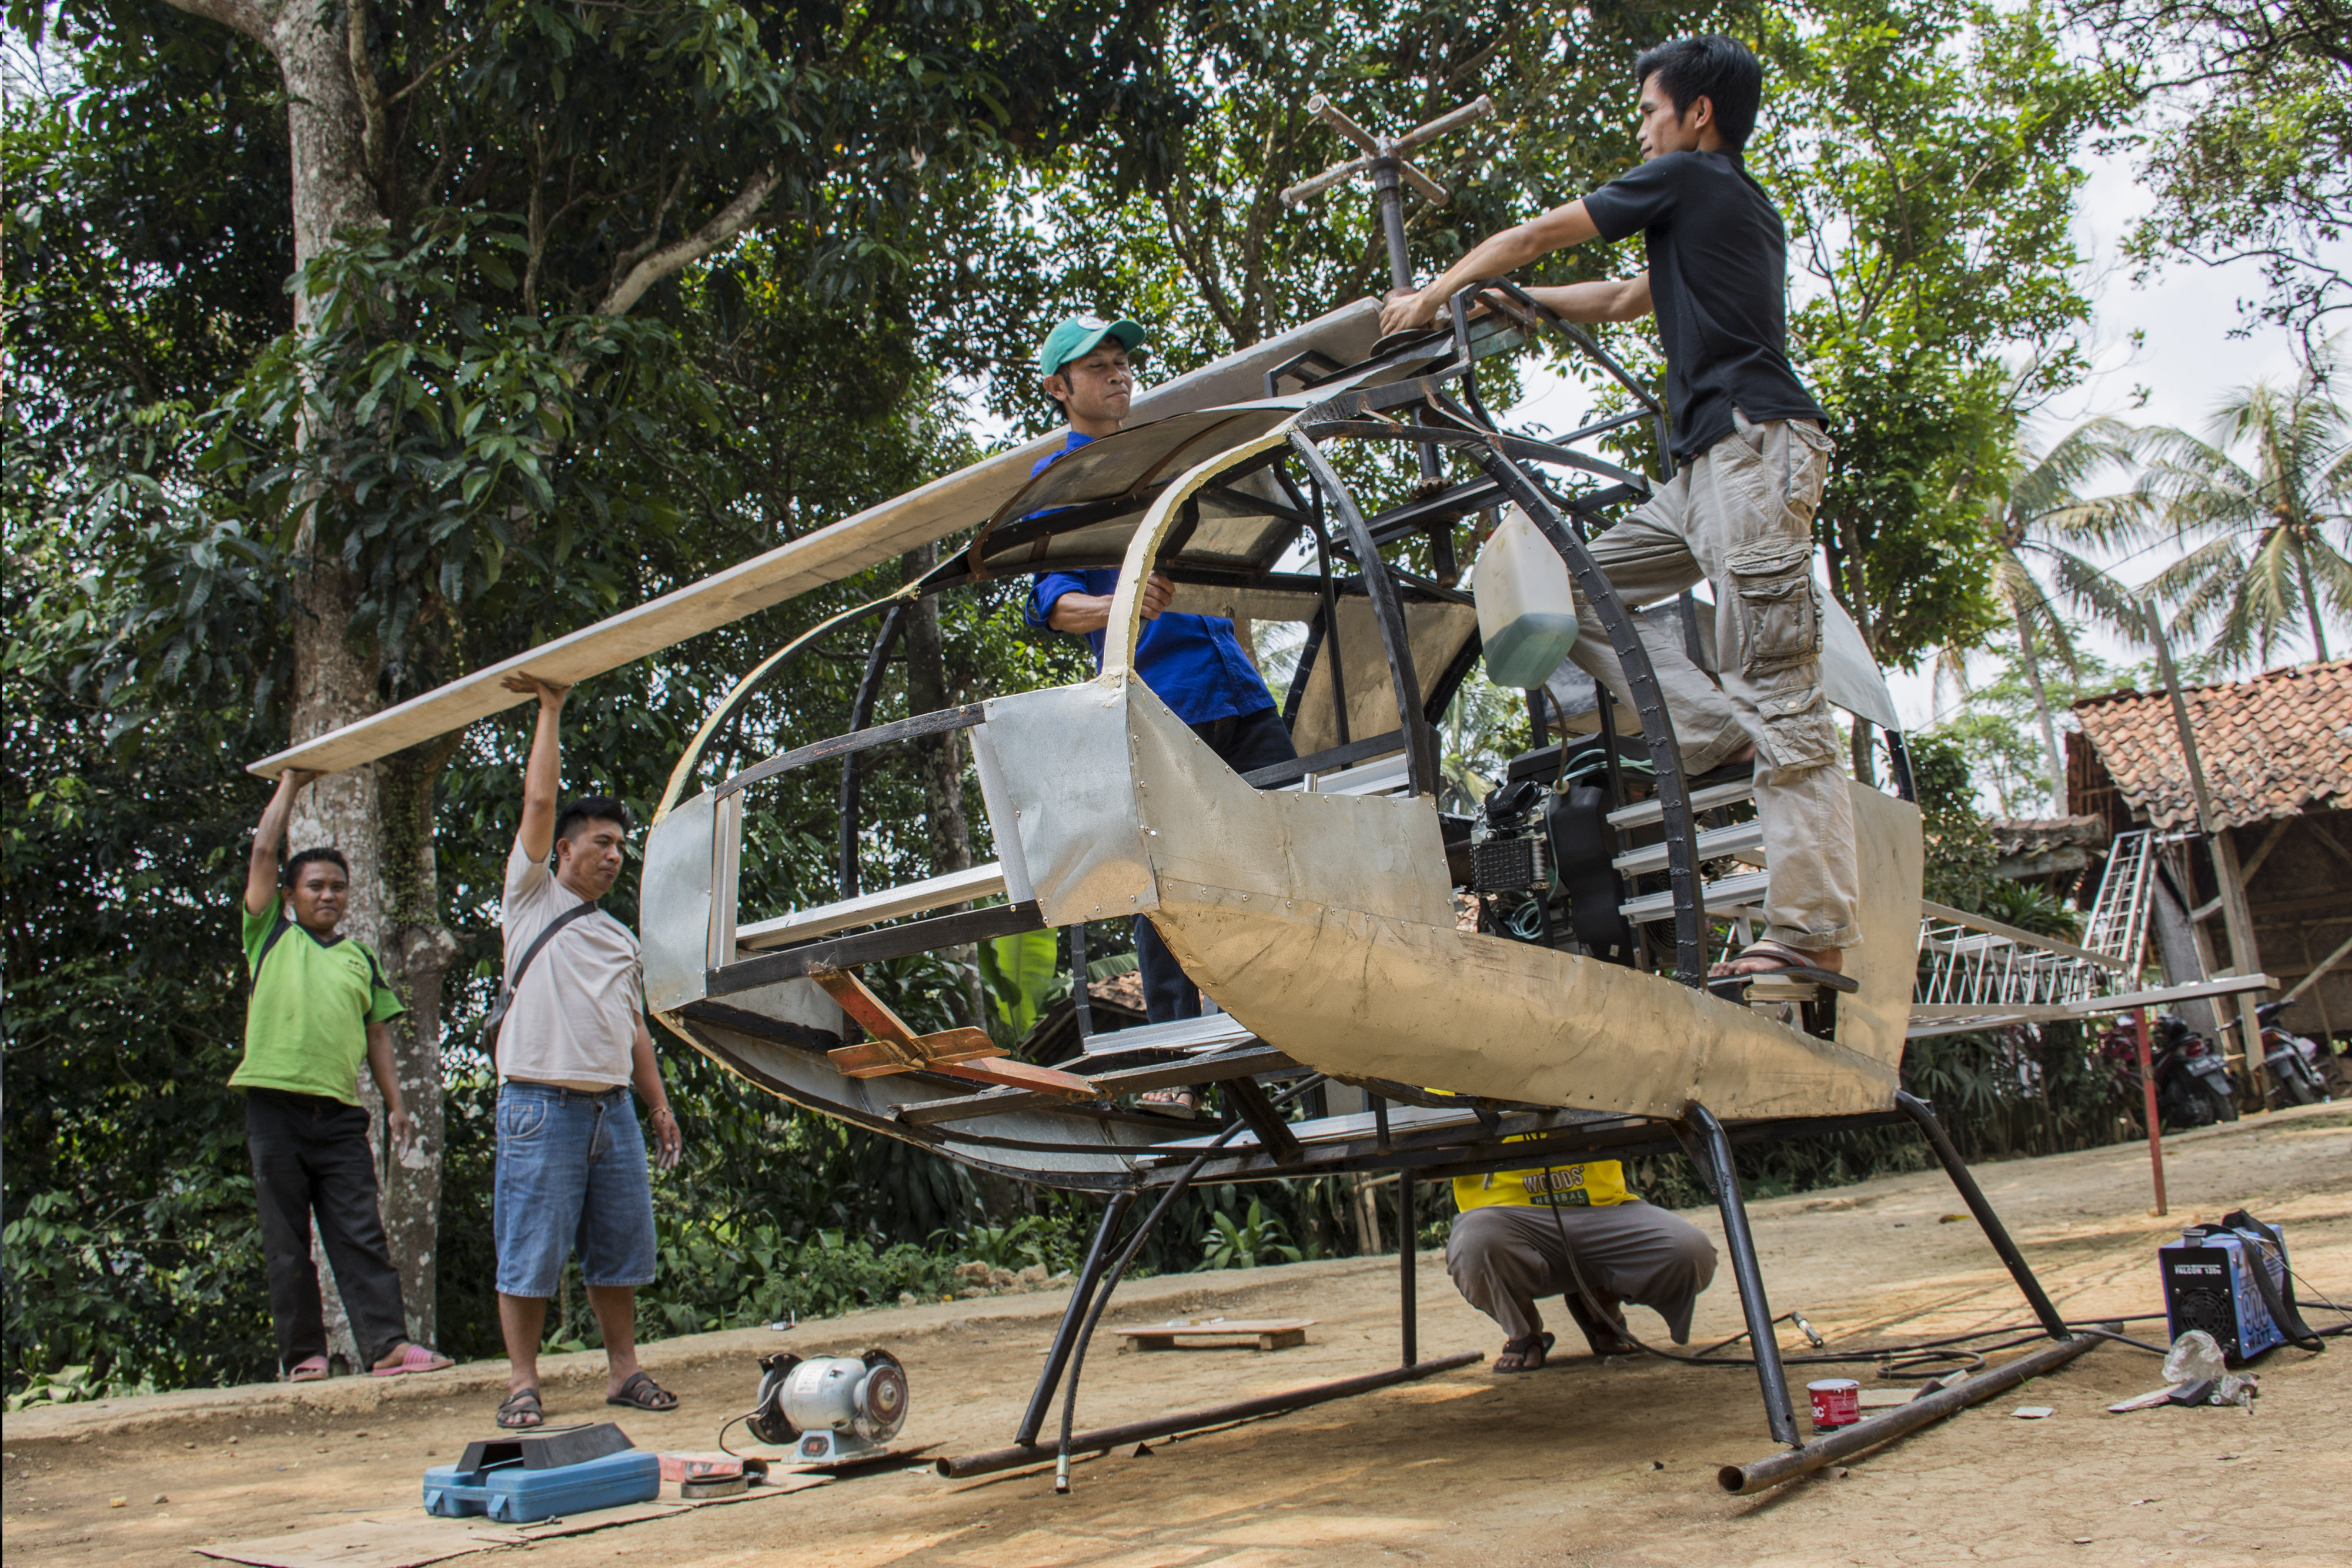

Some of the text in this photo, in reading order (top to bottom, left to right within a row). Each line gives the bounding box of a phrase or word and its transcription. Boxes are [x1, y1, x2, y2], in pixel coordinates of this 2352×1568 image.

[1523, 1165, 1584, 1193] WOODS'
[1536, 1191, 1584, 1205] HERBAL
[2247, 1328, 2271, 1350] WATT
